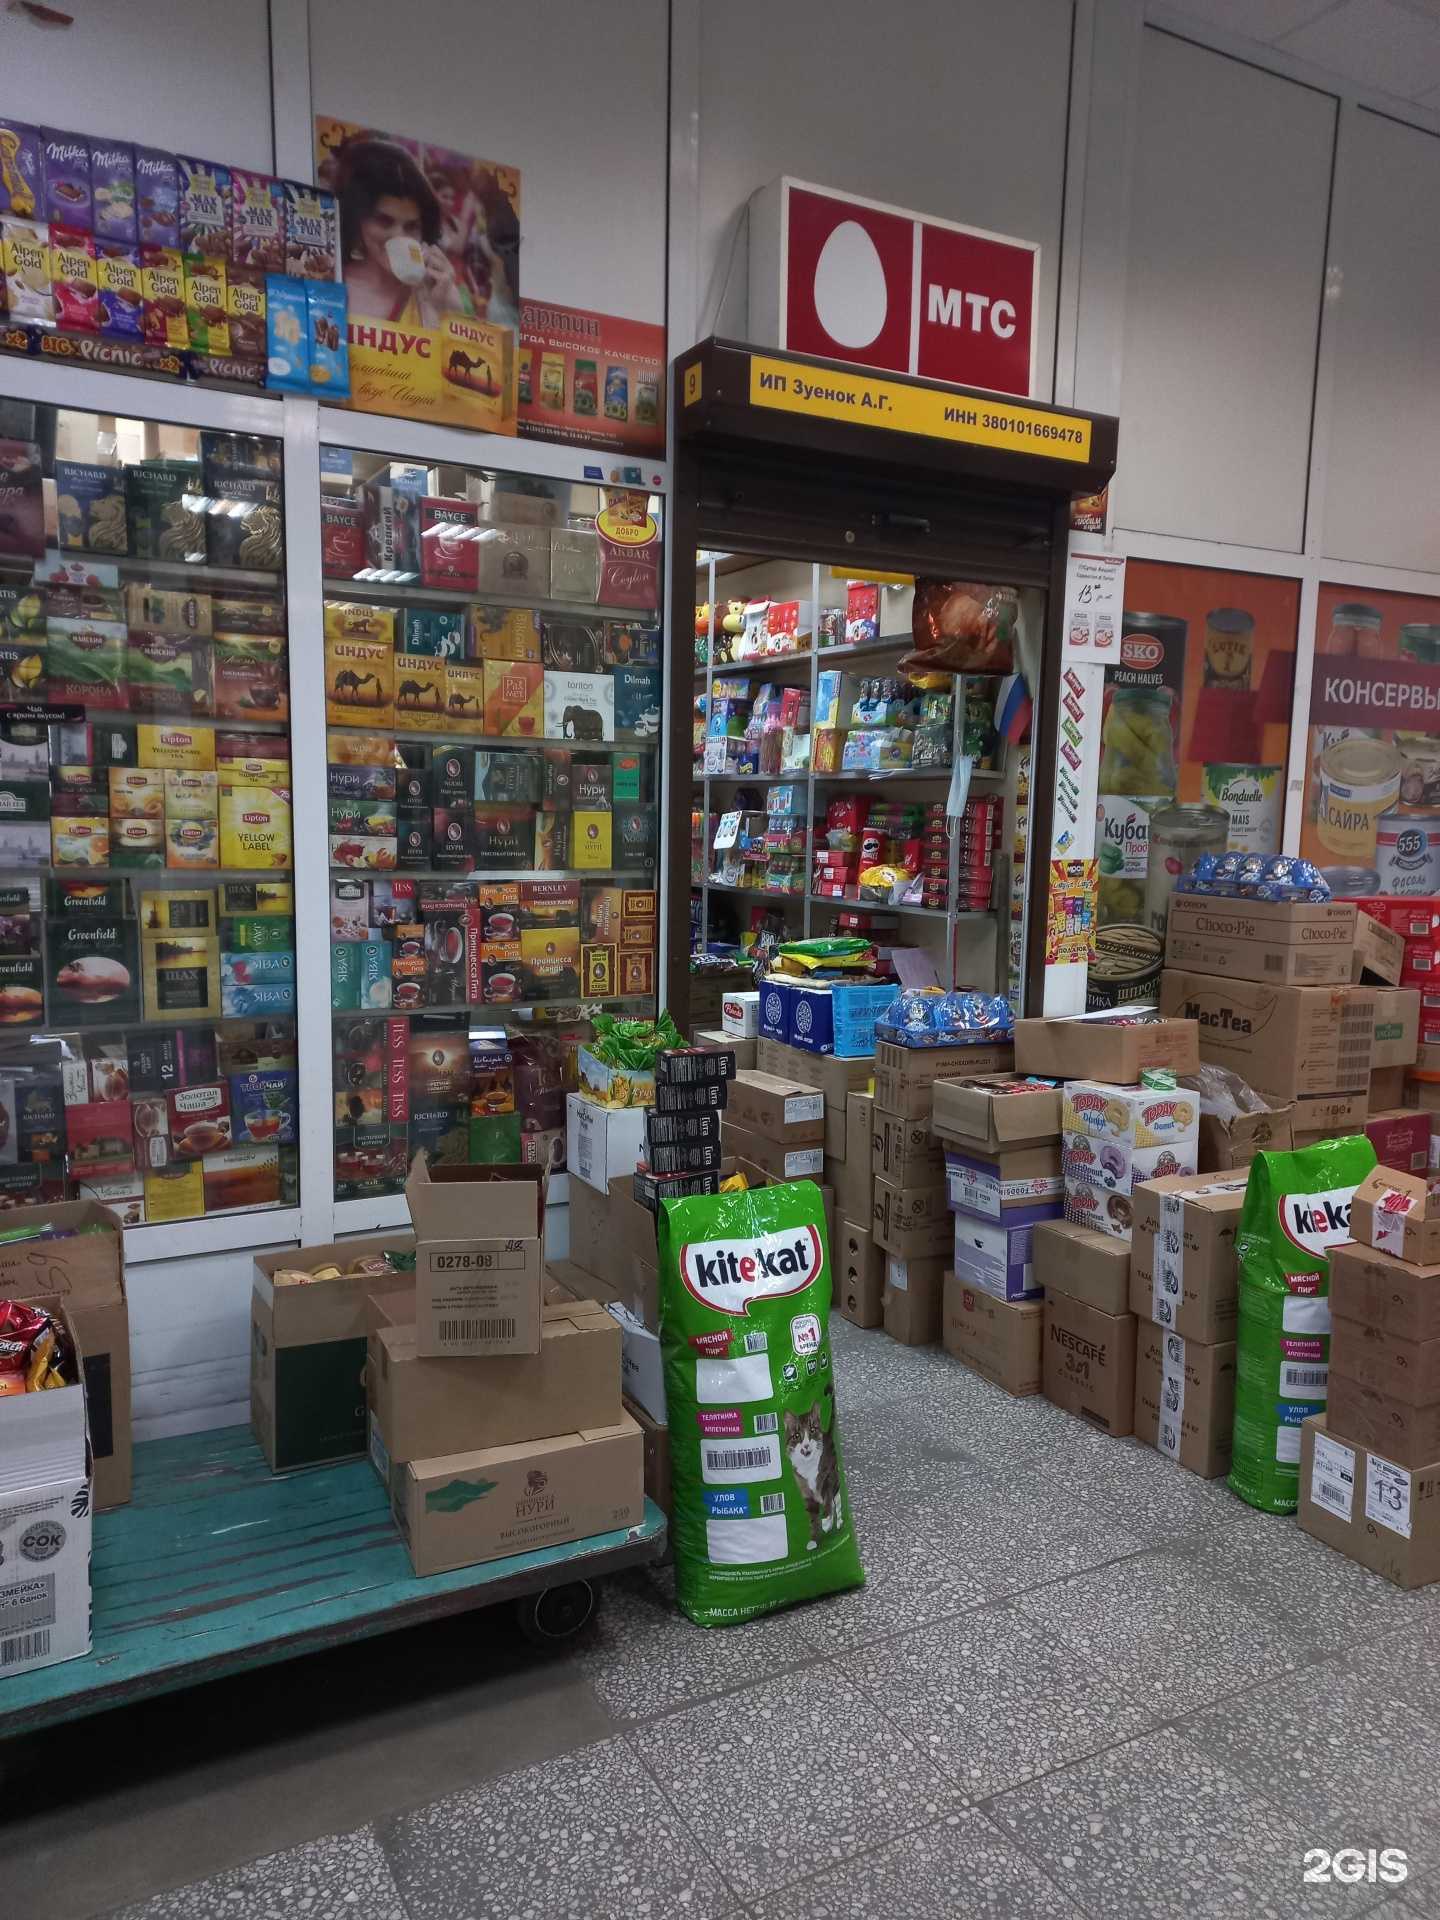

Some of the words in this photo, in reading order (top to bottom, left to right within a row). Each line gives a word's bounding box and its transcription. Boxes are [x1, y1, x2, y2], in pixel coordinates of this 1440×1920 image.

[47, 142, 88, 162] Milka
[92, 151, 129, 169] Milka
[137, 159, 175, 176] Milka
[11, 242, 44, 258] Alpen
[14, 255, 42, 269] Gold
[58, 253, 90, 267] Alpen
[61, 265, 88, 279] Gold
[105, 262, 137, 277] Alpen
[107, 274, 134, 287] Gold
[149, 271, 179, 285] Alpen
[151, 283, 178, 296] Gold
[191, 281, 221, 294] Alpen
[232, 288, 261, 301] Alpen
[194, 293, 219, 305] Gold
[234, 300, 259, 312] Gold
[926, 283, 1017, 339] МТС
[449, 322, 496, 347] ИНДУС
[80, 340, 143, 366] Picnic
[209, 358, 256, 377] Picnic
[688, 378, 696, 394] 9
[759, 372, 786, 392] ИП
[792, 378, 857, 406] Зуенок
[860, 393, 894, 411] А.Г.
[943, 406, 978, 427] ИНН
[981, 413, 1083, 444] 380101669478
[326, 513, 357, 527] BAYCE
[433, 509, 466, 523] BAYCE
[615, 526, 639, 537] ДОБРО
[411, 618, 420, 646] Dilmah
[334, 645, 385, 660] ИНДУС
[397, 656, 442, 671] ИНДУС
[624, 673, 651, 686] Dilmah
[1114, 670, 1137, 683] PEACH
[1137, 672, 1164, 686] HALVES
[161, 734, 192, 745] Lipton
[330, 771, 360, 785] Нури
[578, 783, 605, 796] Нури
[1221, 787, 1264, 808] Bonduelle
[243, 813, 270, 823] Lipton
[331, 807, 361, 820] Нури
[1231, 814, 1250, 826] MAIS
[1328, 807, 1369, 832] САЙРА
[238, 832, 275, 843] YELLOW
[1398, 836, 1421, 851] 555
[243, 841, 272, 851] LABEL
[532, 884, 568, 893] BERNLEY
[64, 895, 107, 907] Greenfield
[67, 928, 117, 941] Greenfield
[468, 927, 478, 978] Принцесса
[470, 979, 479, 999] Гита
[1183, 1001, 1253, 1034] MacTea
[391, 1057, 405, 1084] TESS
[391, 1093, 405, 1118] TESS
[1071, 1093, 1109, 1114] TODAY
[1142, 1101, 1178, 1127] TODAY
[1153, 1121, 1175, 1131] Donut
[1066, 1149, 1097, 1165] TODAY
[1070, 1196, 1100, 1211] TODAY
[437, 1254, 494, 1269] 0278-08
[695, 1239, 810, 1288] kitekat
[1290, 1272, 1320, 1283] МЯСНОЙ
[696, 1332, 729, 1345] МЯСНОЙ
[701, 1412, 738, 1422] ТЕЛЯТИНКА
[1288, 1406, 1309, 1414] УЛОВ
[704, 1425, 740, 1433] АППЕТИТНАЯ
[714, 1493, 736, 1503] УЛОВ
[515, 1499, 555, 1518] НУРИ
[711, 1506, 745, 1516] РЫБАКА
[22, 1534, 62, 1548] СОК
[20, 1592, 48, 1605] банок
[709, 1607, 738, 1618] МАССА
